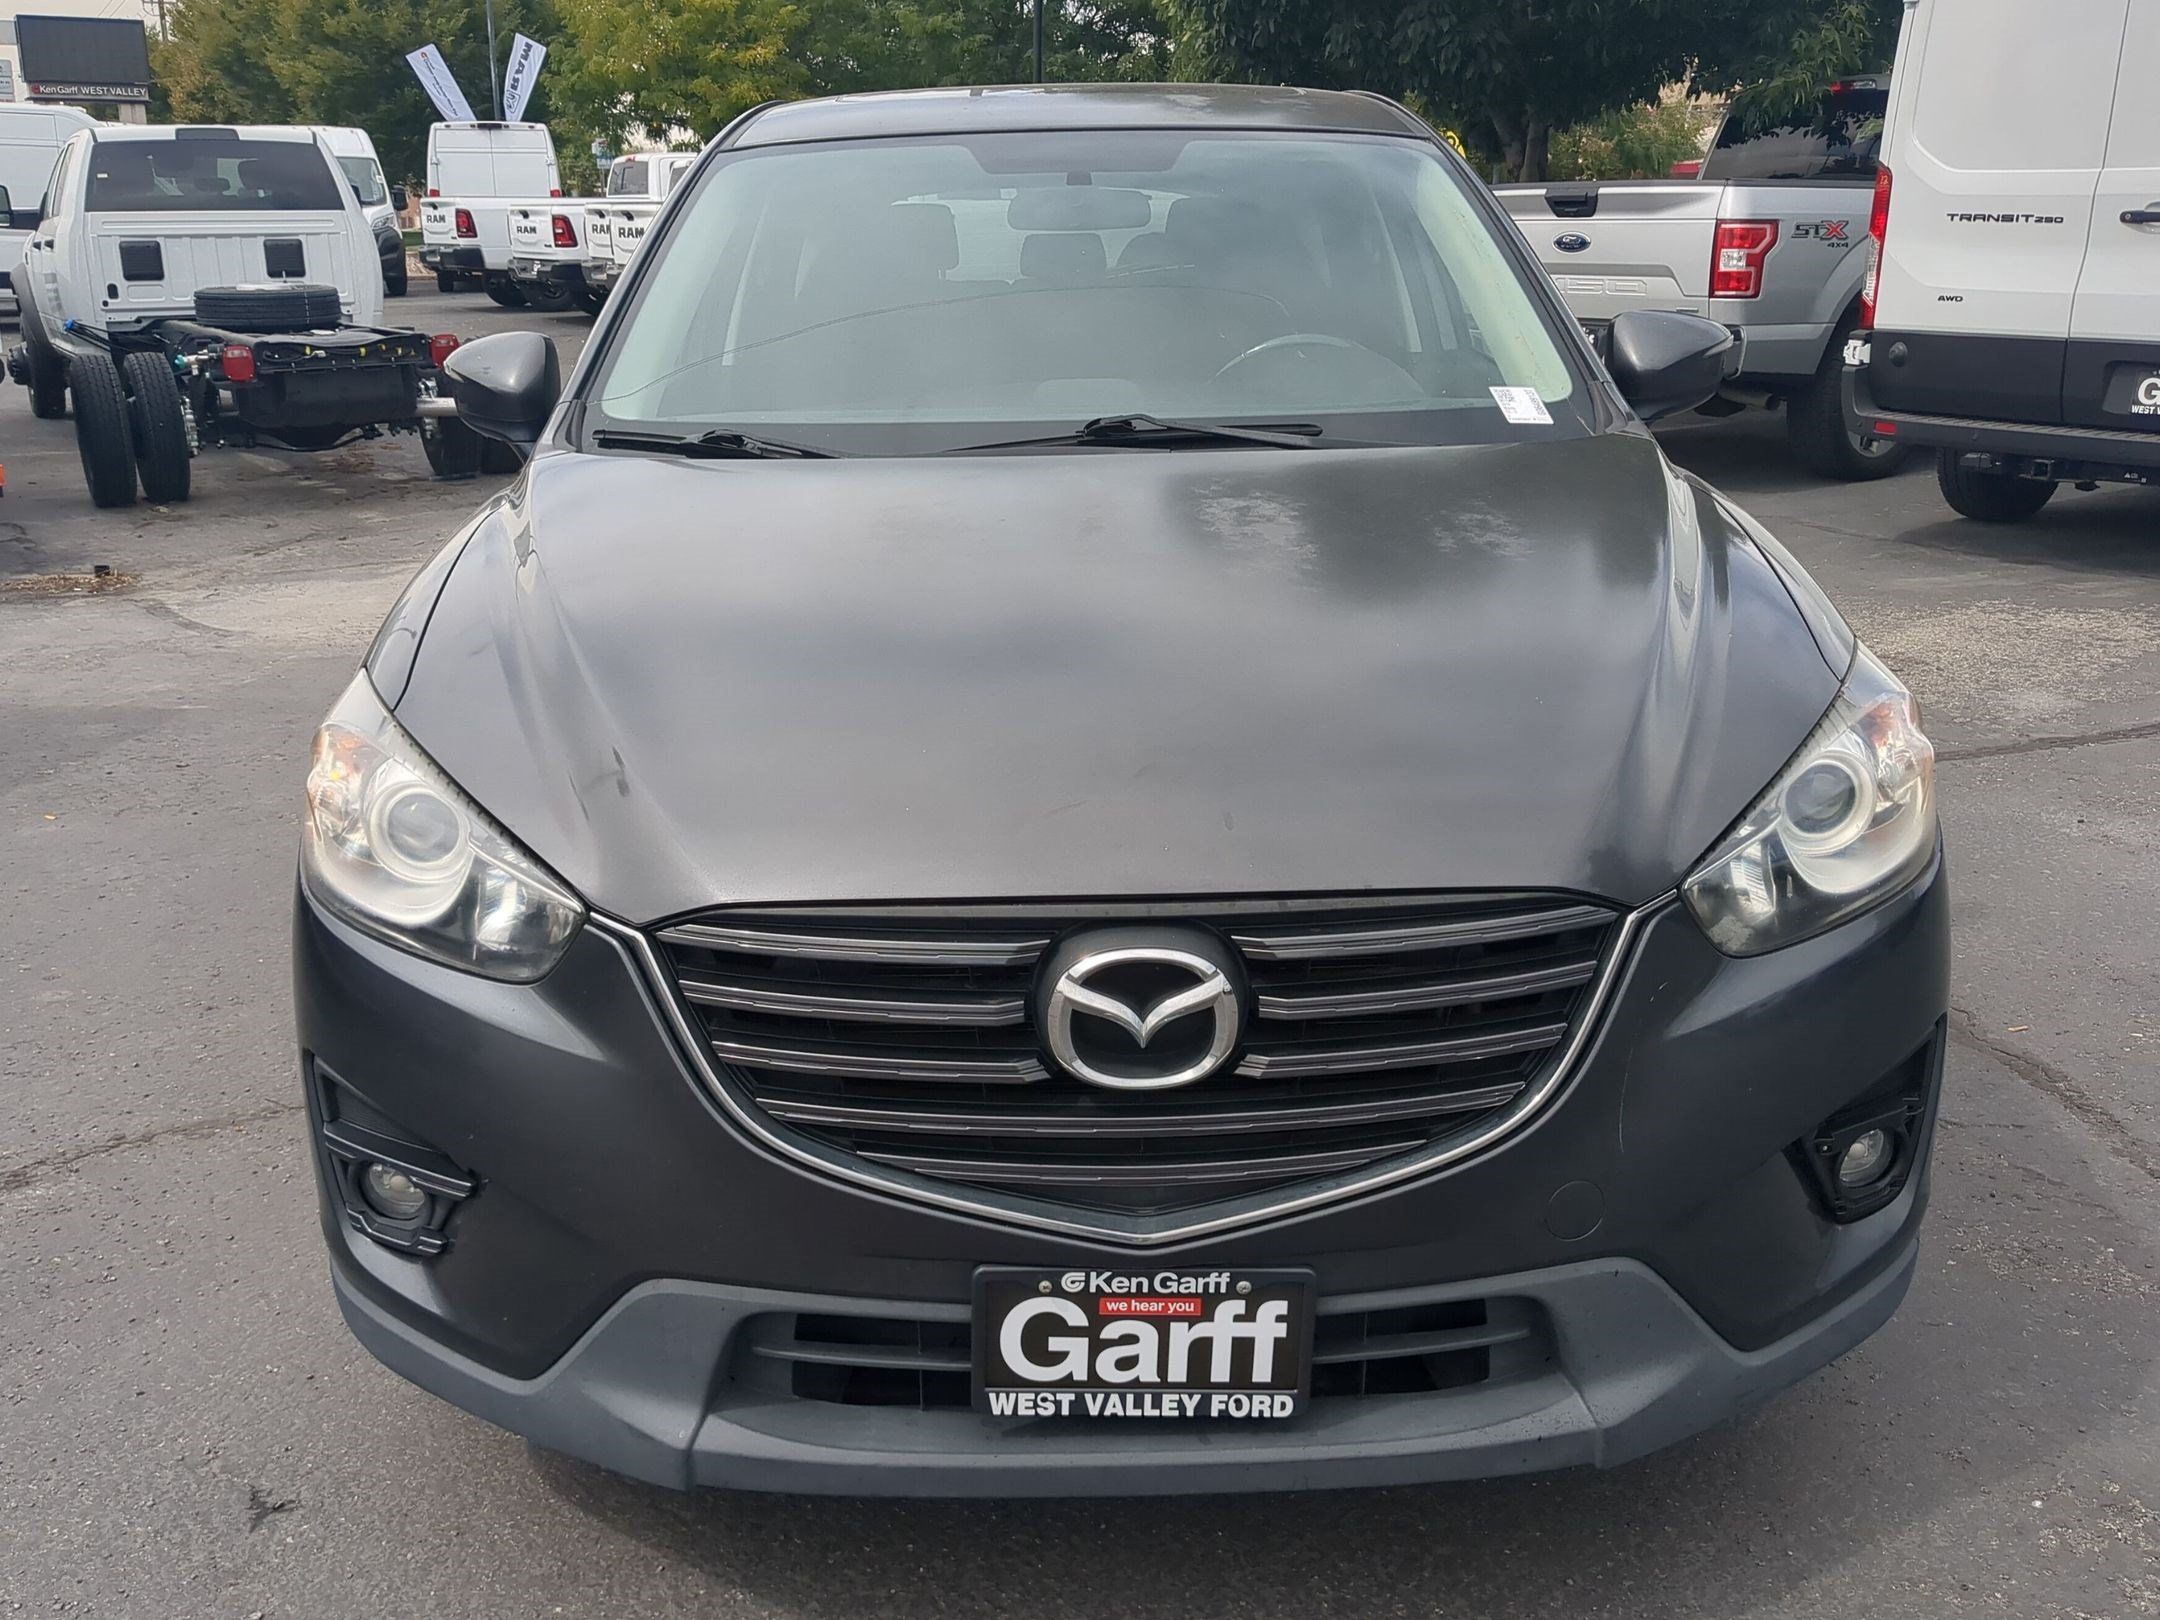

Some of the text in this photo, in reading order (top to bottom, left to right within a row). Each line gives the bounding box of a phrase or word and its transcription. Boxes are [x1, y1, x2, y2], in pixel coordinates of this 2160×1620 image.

[40, 85, 146, 96] Ken Garff WEST VALLEY
[426, 214, 446, 224] RAM
[1947, 213, 2034, 223] TRANSIT
[516, 225, 537, 234] RAM
[618, 226, 645, 238] RAM
[1791, 220, 1849, 240] STX
[2131, 405, 2156, 414] WEST
[1089, 1272, 1230, 1293] Ken Garff
[1106, 1300, 1195, 1314] we hear you
[999, 1296, 1289, 1384] Garff
[988, 1393, 1294, 1418] WEST VALLEY FORD
